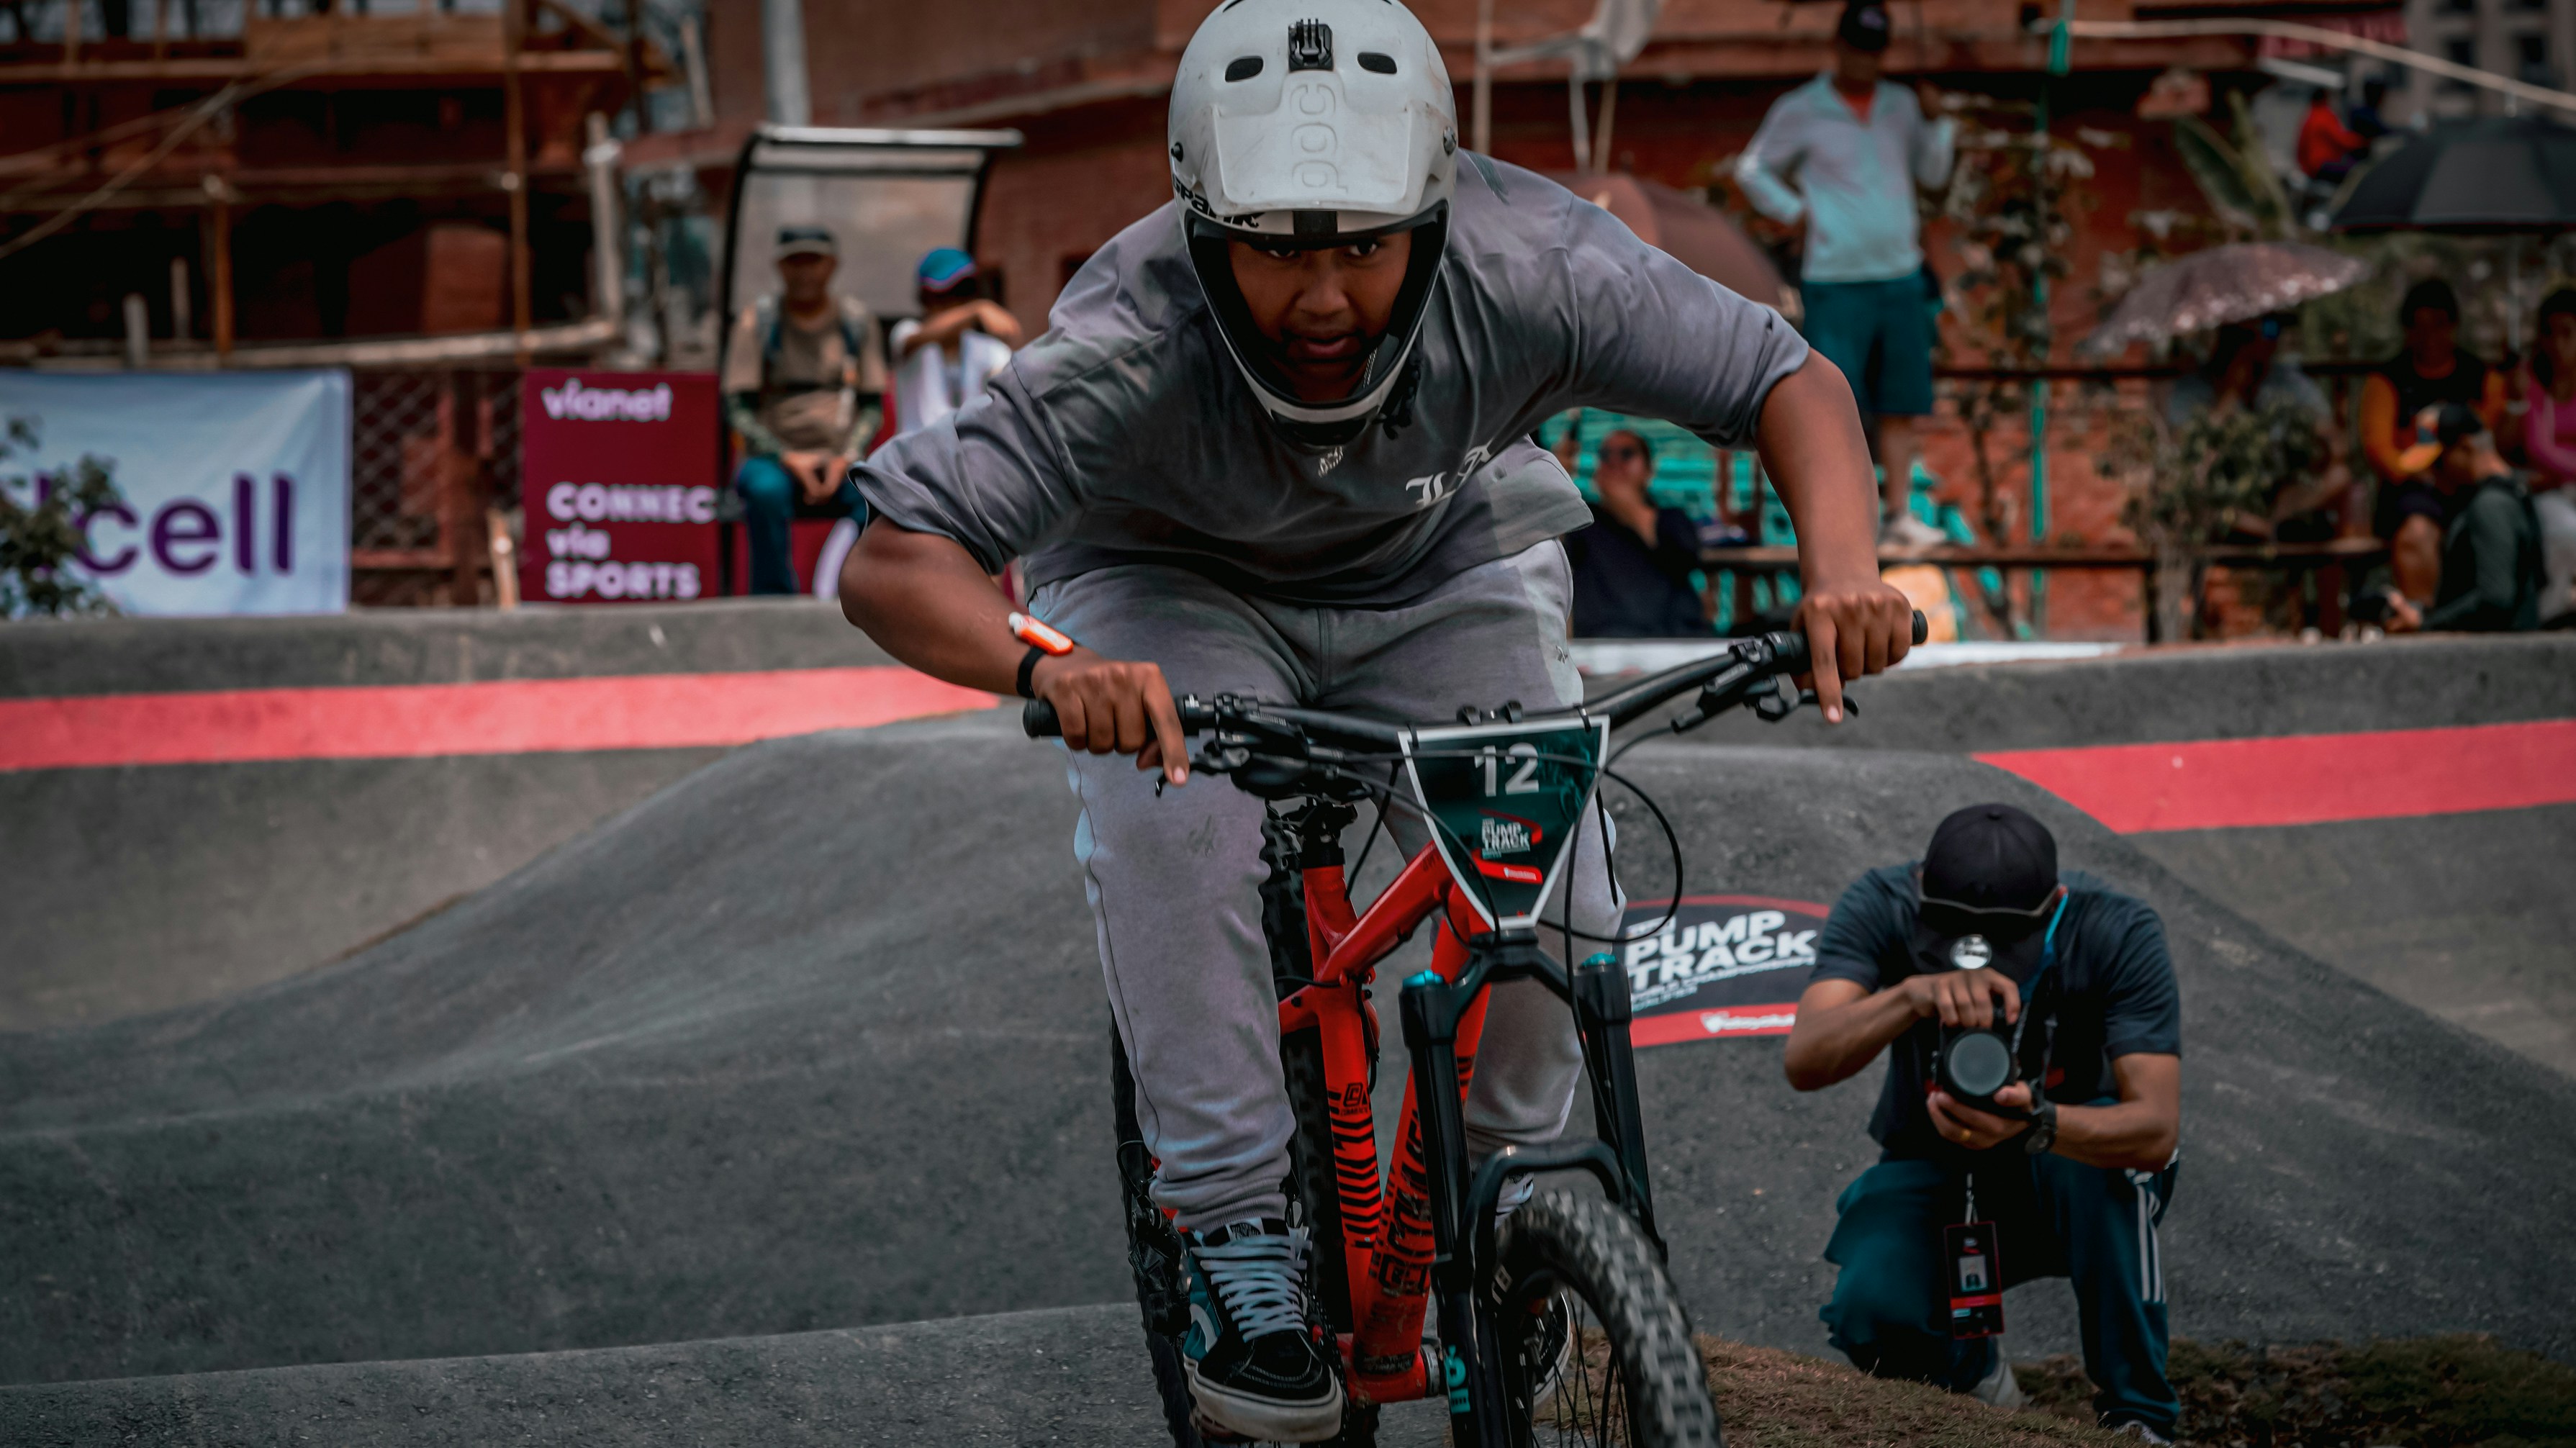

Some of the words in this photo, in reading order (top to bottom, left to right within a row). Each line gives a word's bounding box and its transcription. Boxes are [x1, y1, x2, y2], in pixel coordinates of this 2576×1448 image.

[542, 378, 673, 422] vianet
[545, 521, 611, 560] via
[545, 561, 701, 599] SPORTS
[1474, 742, 1540, 797] 12
[1624, 910, 1786, 969] PUMP
[1627, 930, 1817, 992] TRACK
